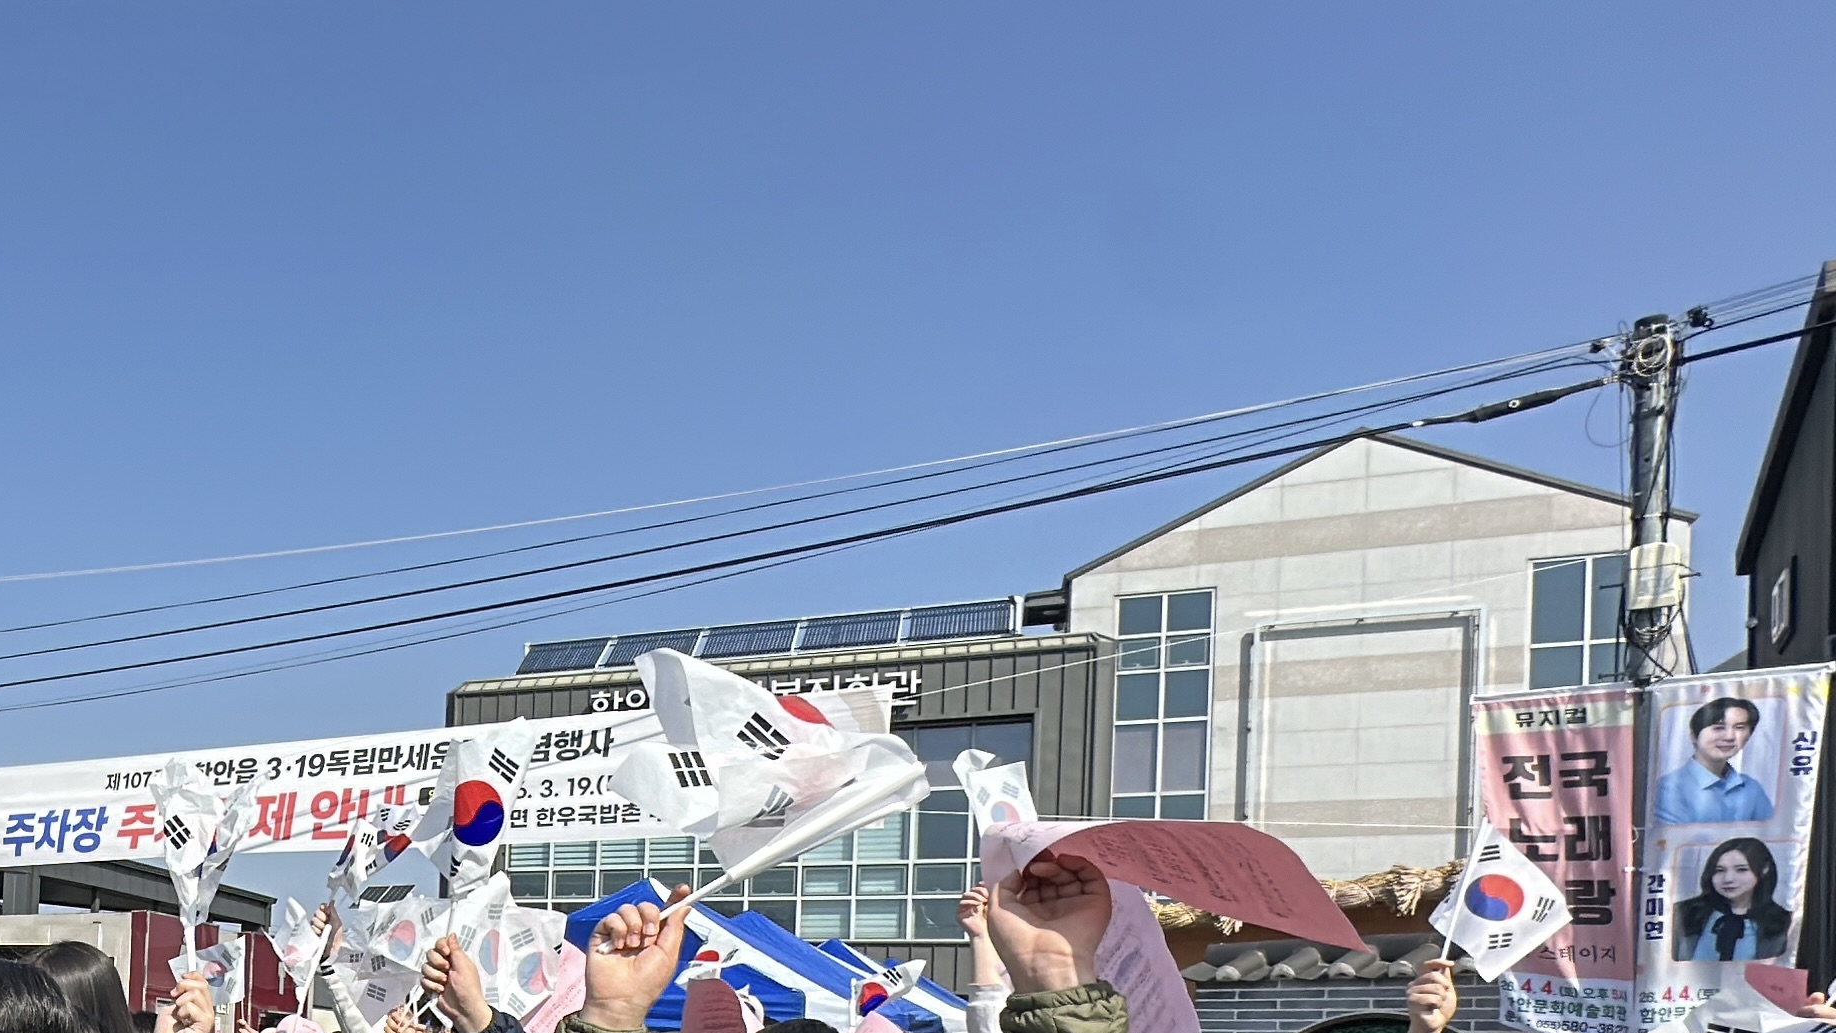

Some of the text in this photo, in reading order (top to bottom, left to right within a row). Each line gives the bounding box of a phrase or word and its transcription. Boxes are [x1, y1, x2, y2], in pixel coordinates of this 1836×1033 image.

[1515, 707, 1588, 728] 뮤지컬
[105, 768, 162, 791] 제107
[266, 740, 451, 780] 3·19독립만세운
[530, 727, 614, 763] 념행사
[1501, 750, 1612, 800] 전국
[1789, 731, 1818, 777] 신유
[2, 806, 109, 857] 주차장
[536, 802, 641, 828] 한우국밥촌
[1508, 815, 1612, 862] 노래
[1565, 880, 1616, 926] 랑
[1645, 874, 1665, 941] 간미연
[1583, 987, 1609, 999] 오후
